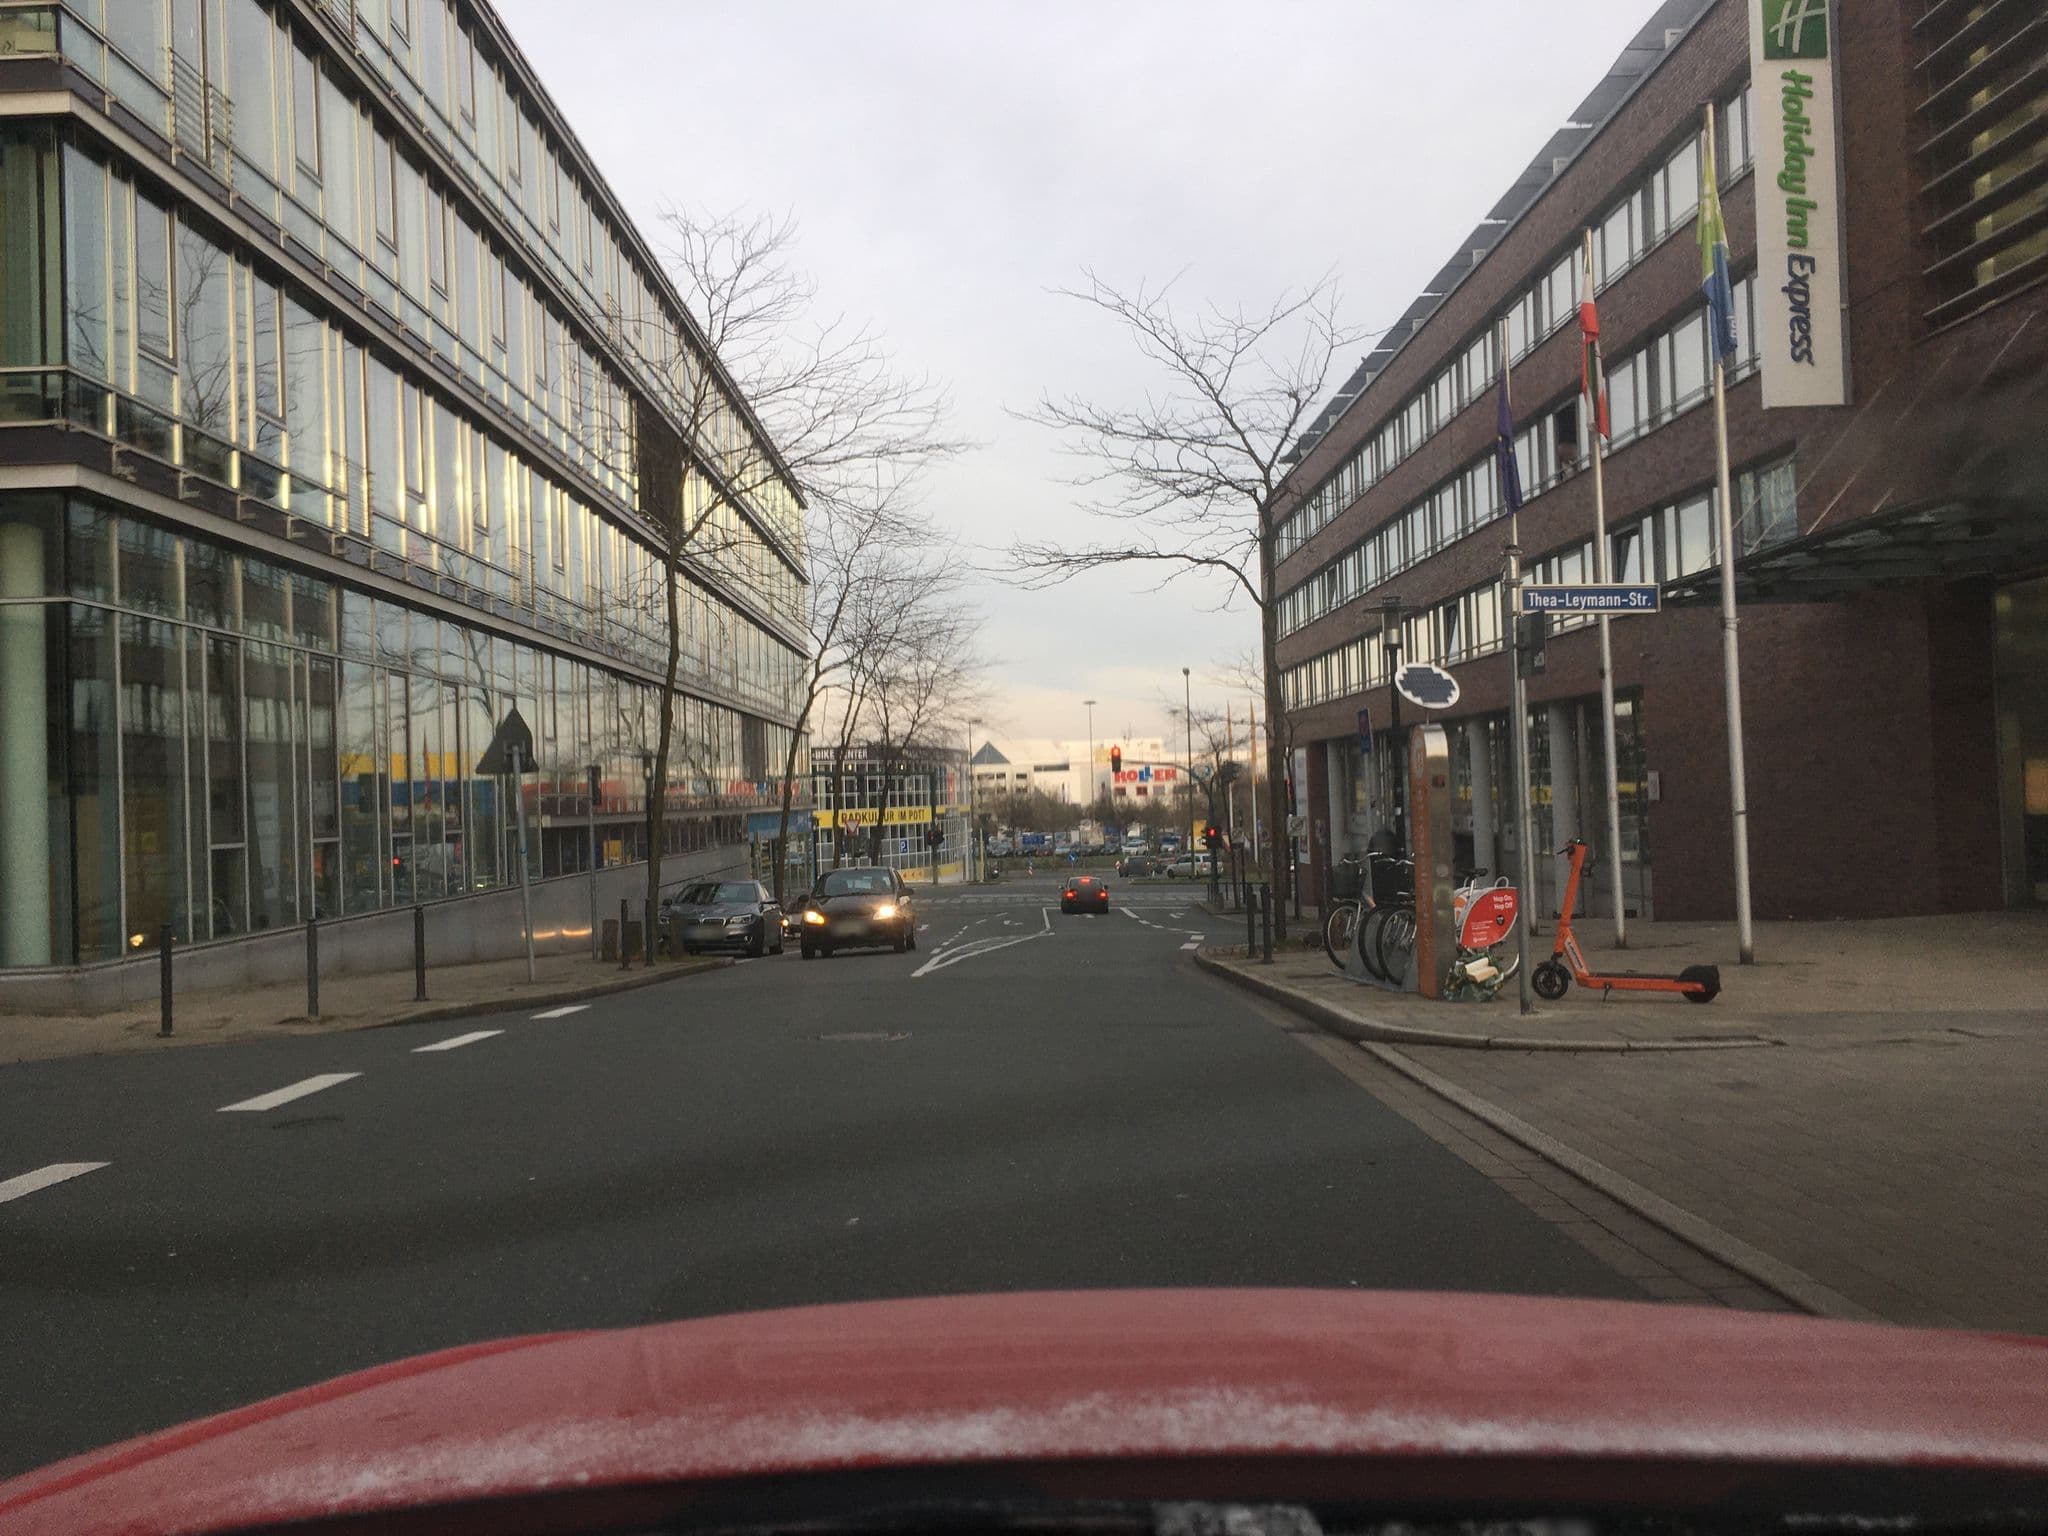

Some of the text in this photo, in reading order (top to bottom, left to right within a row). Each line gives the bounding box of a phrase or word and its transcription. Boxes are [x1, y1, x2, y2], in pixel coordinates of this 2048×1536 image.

[1777, 69, 1817, 366] Holiday Inn Express
[1528, 592, 1652, 610] Thea-Leymann-Str.
[908, 809, 925, 820] POTT
